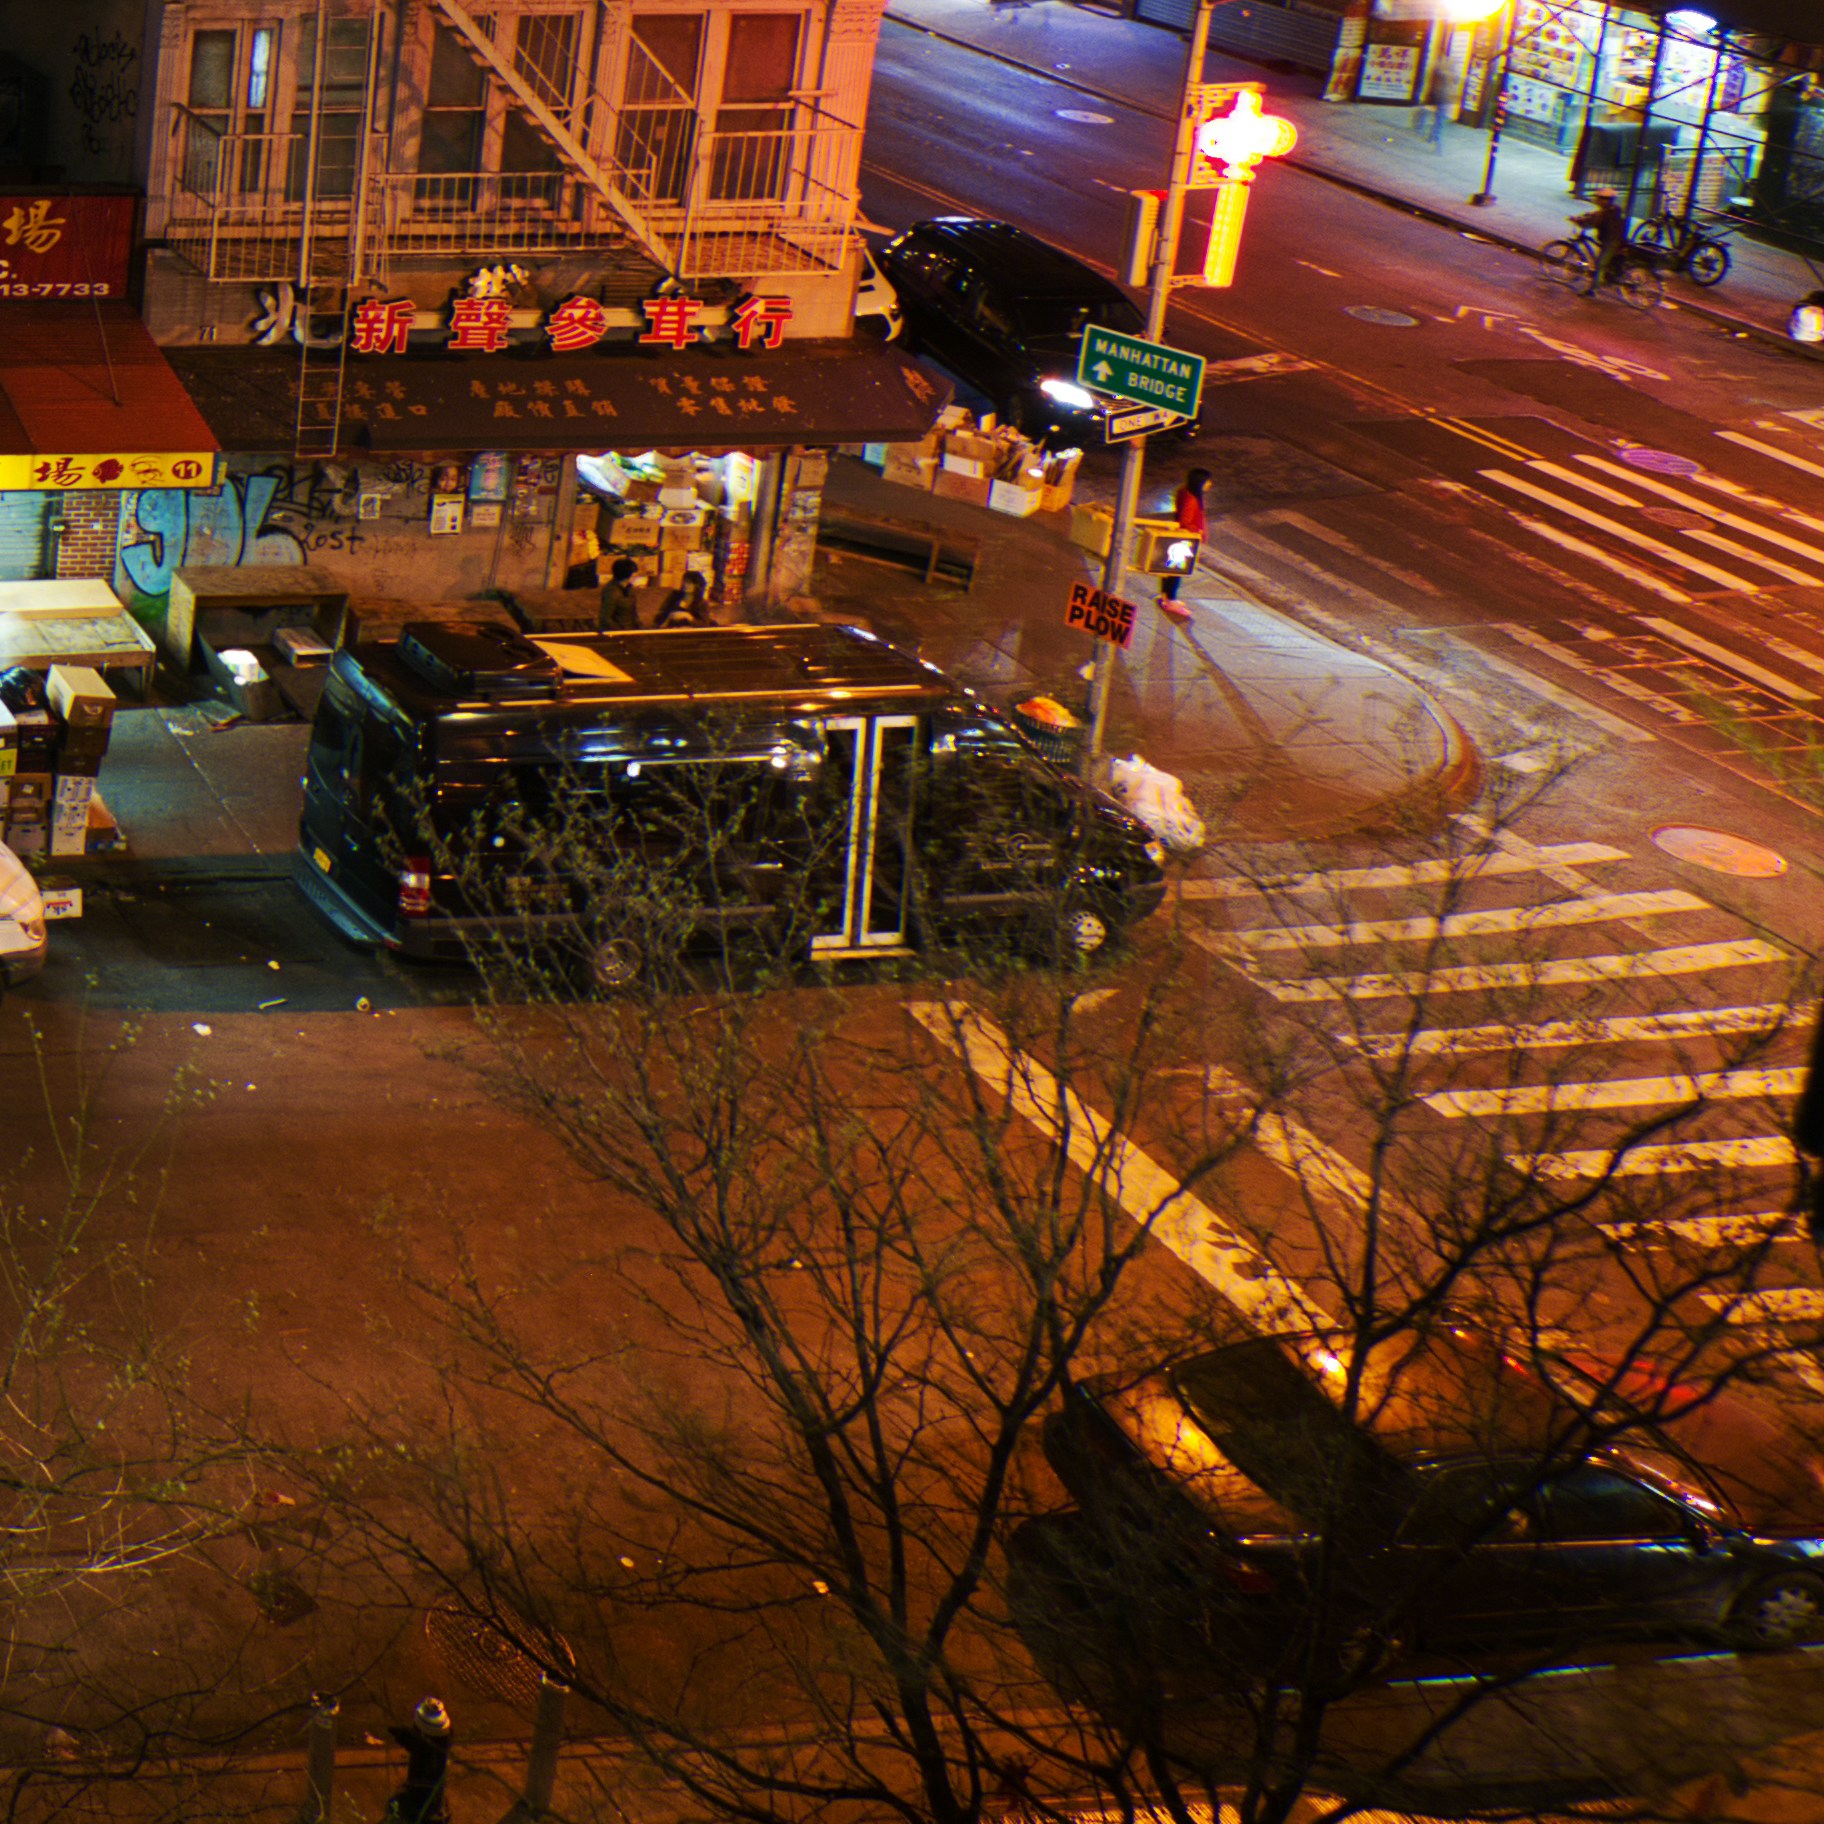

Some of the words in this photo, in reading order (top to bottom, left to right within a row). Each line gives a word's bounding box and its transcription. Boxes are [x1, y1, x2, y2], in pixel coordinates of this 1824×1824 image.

[1095, 338, 1193, 379] MANHATTAN
[1127, 371, 1188, 404] BRIDGE
[1119, 416, 1142, 431] ONE
[1068, 604, 1131, 644] PLOW
[1072, 584, 1136, 625] RAISE
